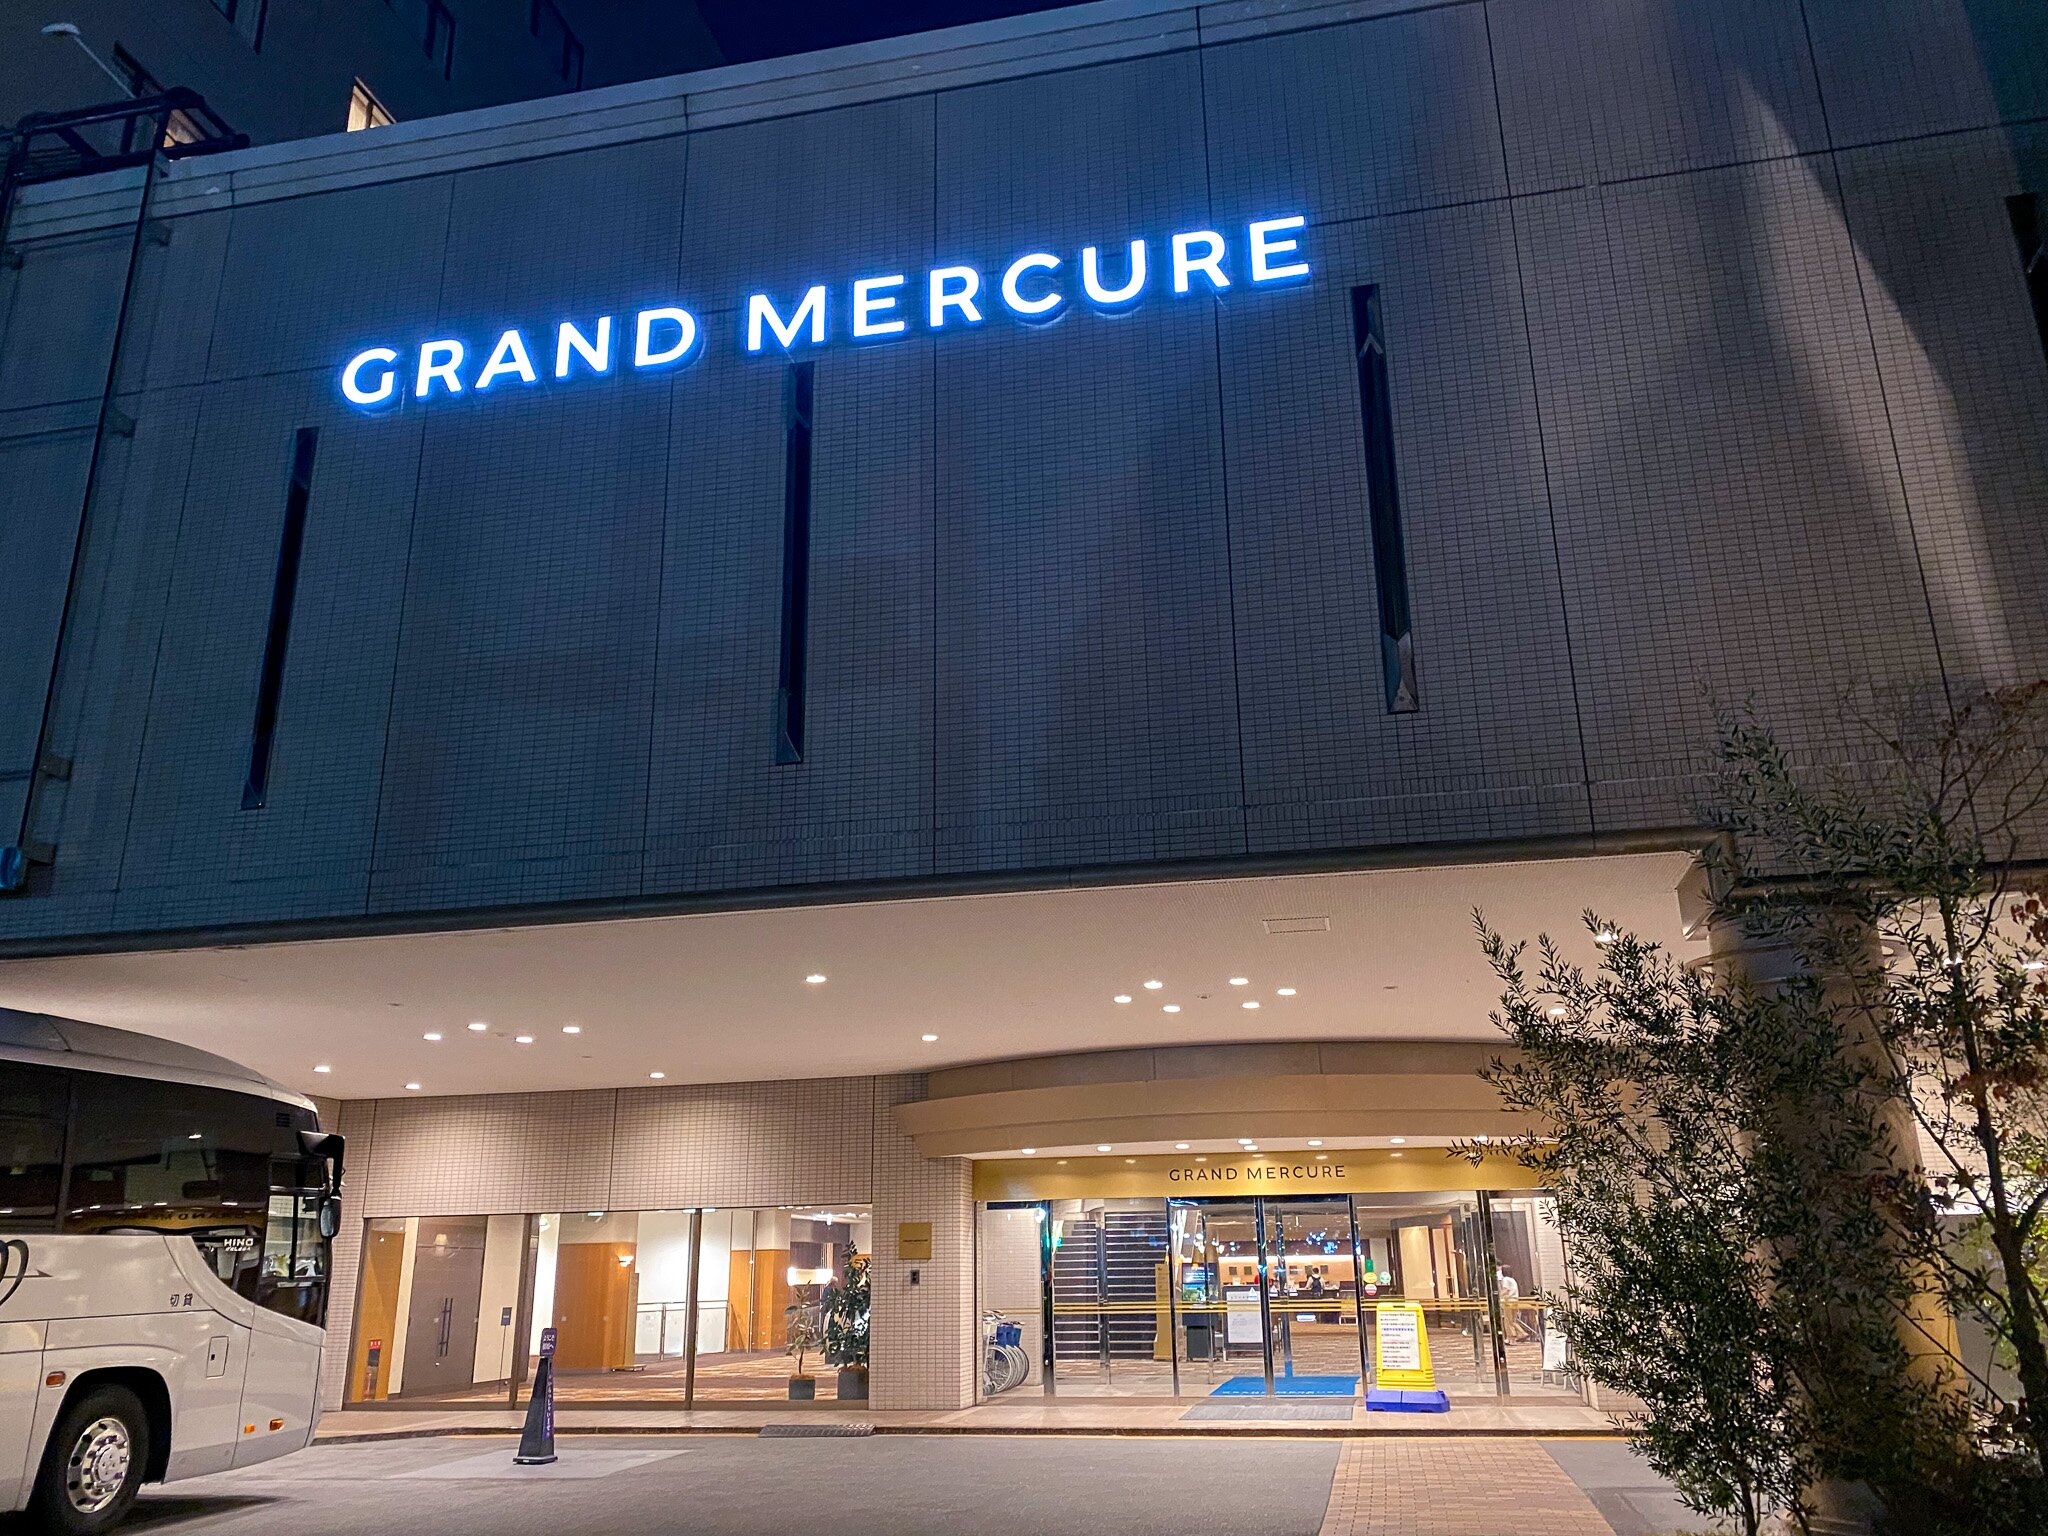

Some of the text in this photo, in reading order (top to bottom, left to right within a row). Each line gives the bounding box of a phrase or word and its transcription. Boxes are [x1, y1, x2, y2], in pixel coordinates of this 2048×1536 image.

[342, 216, 1310, 404] GRAND MERCURE
[1169, 1165, 1346, 1181] GRAND MERCURE
[224, 1238, 254, 1247] HINO
